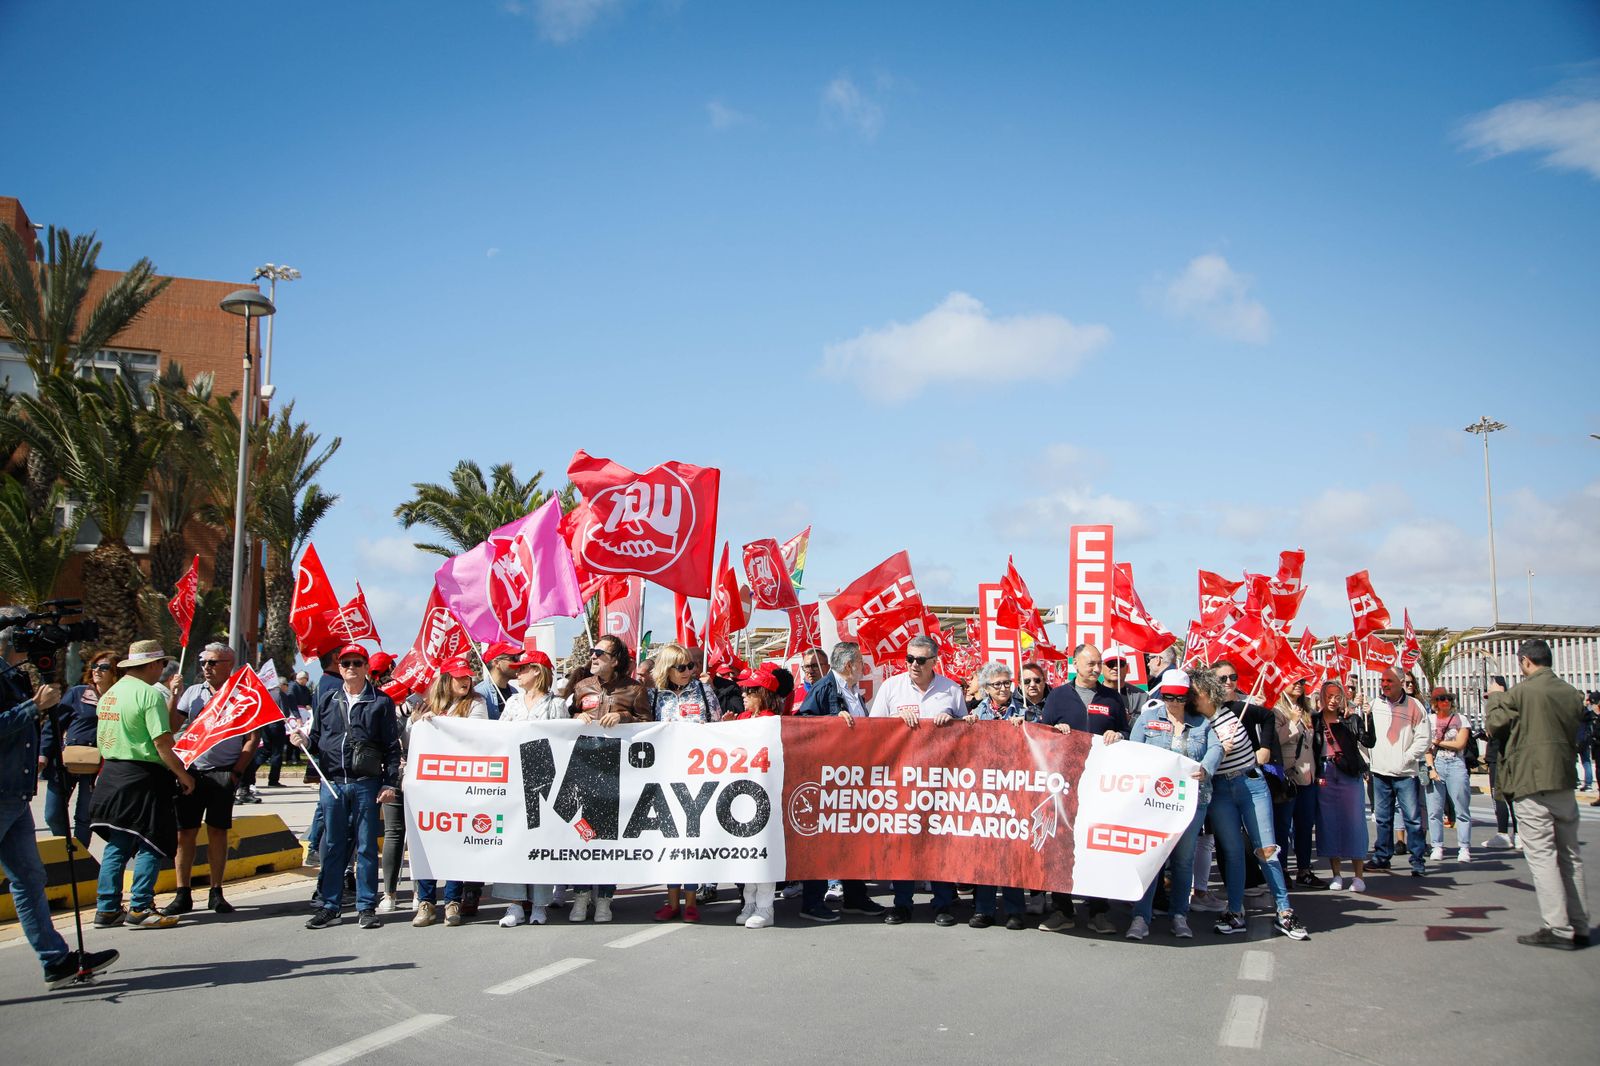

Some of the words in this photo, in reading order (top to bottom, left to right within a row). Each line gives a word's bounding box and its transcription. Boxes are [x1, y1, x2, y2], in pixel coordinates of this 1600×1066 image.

[422, 760, 488, 778] CCOO
[687, 747, 771, 775] 2024
[821, 766, 864, 786] POR
[870, 766, 896, 786] EL
[902, 767, 976, 789] PLENO
[982, 769, 1070, 795] EMPLEO:
[1100, 774, 1150, 793] UGT
[465, 786, 506, 796] Almería
[820, 789, 898, 810] MENOS
[904, 790, 1016, 817] JORNADA,
[1144, 798, 1184, 812] Almería
[418, 811, 467, 833] UGT
[818, 812, 922, 835] MEJORES
[928, 814, 1029, 840] SALARIOS
[463, 836, 503, 846] Almería
[528, 849, 653, 861] #PLENOEMPLEO
[669, 847, 768, 860] #1MAYO2024
